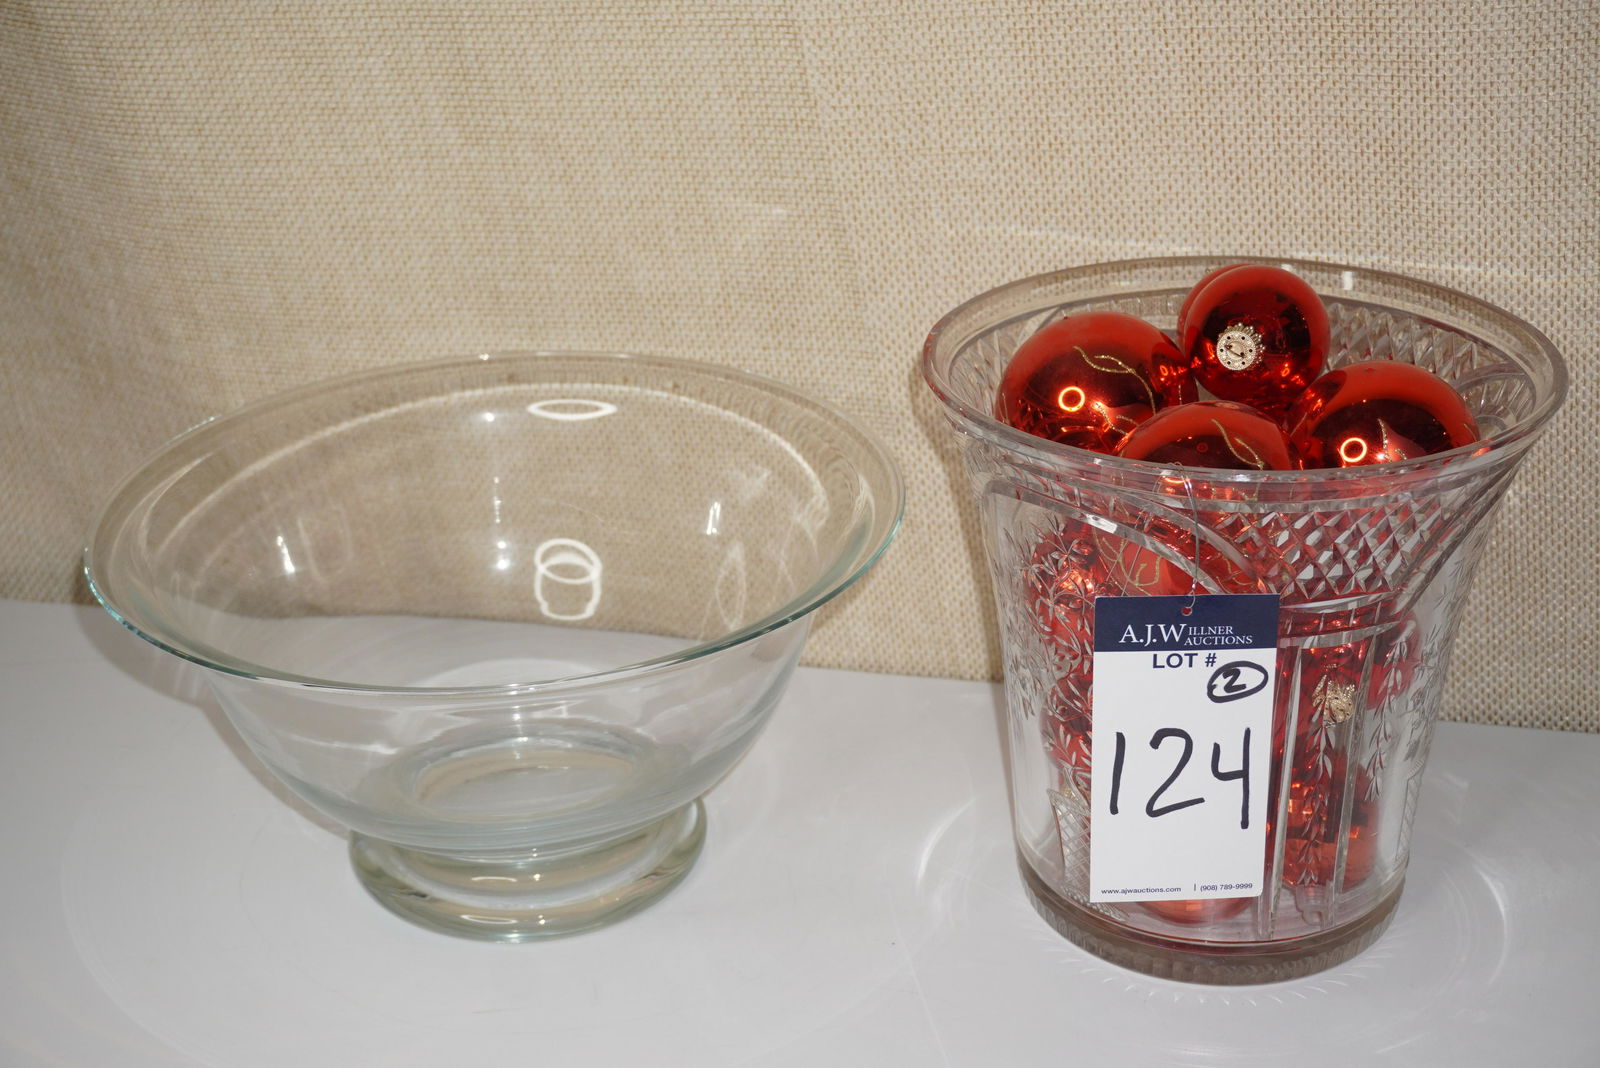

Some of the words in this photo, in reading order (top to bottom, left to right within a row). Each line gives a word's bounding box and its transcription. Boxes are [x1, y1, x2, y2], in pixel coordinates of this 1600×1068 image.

[1184, 635, 1253, 646] AUCTIONS
[1152, 653, 1198, 668] LOT
[1204, 652, 1217, 667] #
[1222, 668, 1246, 693] 2
[1110, 727, 1250, 829] 124
[1101, 886, 1181, 895] www.ajwauctions.com
[1219, 883, 1252, 891] 789-9999
